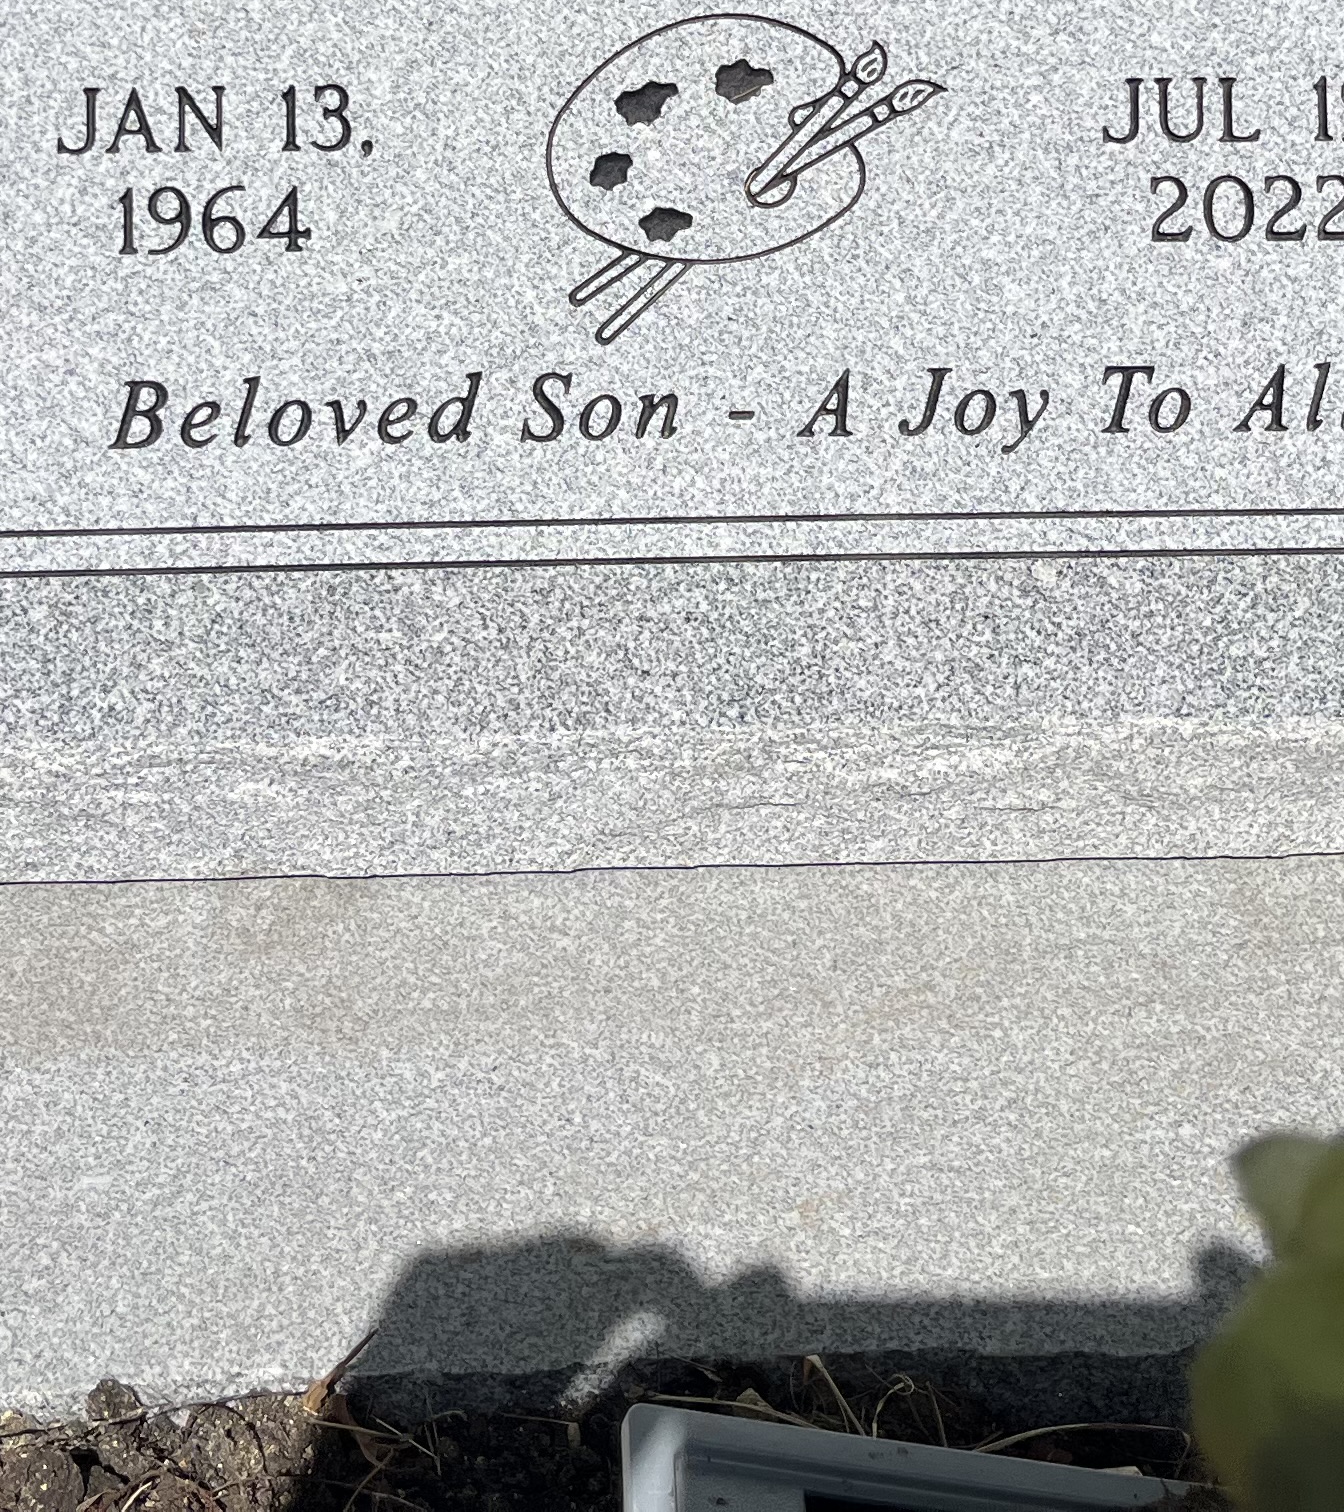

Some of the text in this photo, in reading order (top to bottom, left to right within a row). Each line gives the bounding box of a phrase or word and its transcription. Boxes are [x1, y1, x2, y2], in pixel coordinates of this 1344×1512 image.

[56, 83, 374, 158] JAN 13,
[1102, 76, 1260, 144] JUL
[118, 184, 312, 255] 1964
[112, 371, 483, 450] Beloved
[521, 371, 679, 443] Son
[727, 408, 755, 421] -
[798, 371, 854, 438] A
[897, 367, 1050, 455] Joy
[1103, 364, 1192, 434] To
